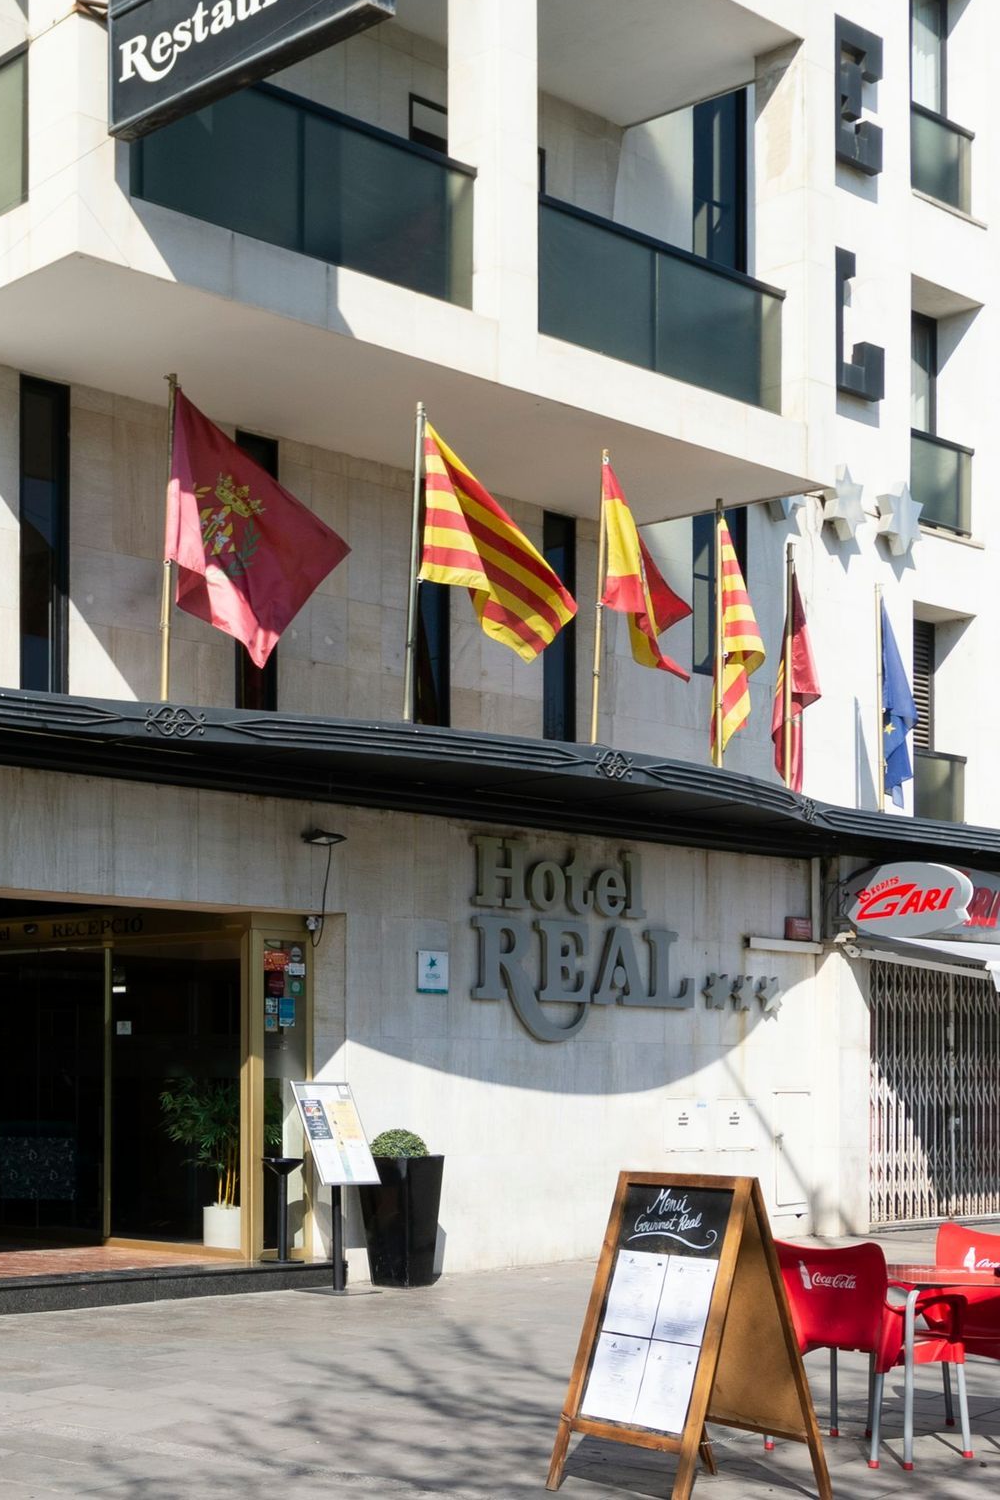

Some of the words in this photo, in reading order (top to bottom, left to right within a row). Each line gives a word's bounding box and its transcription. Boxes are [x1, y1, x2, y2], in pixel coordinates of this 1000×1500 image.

[471, 835, 648, 919] Hotel
[856, 883, 955, 921] GARI
[51, 913, 144, 938] RECEPCIÓ
[470, 914, 696, 1043] REAL
[646, 1188, 692, 1215] Menú
[634, 1213, 676, 1232] Gourmet
[677, 1212, 703, 1232] Real
